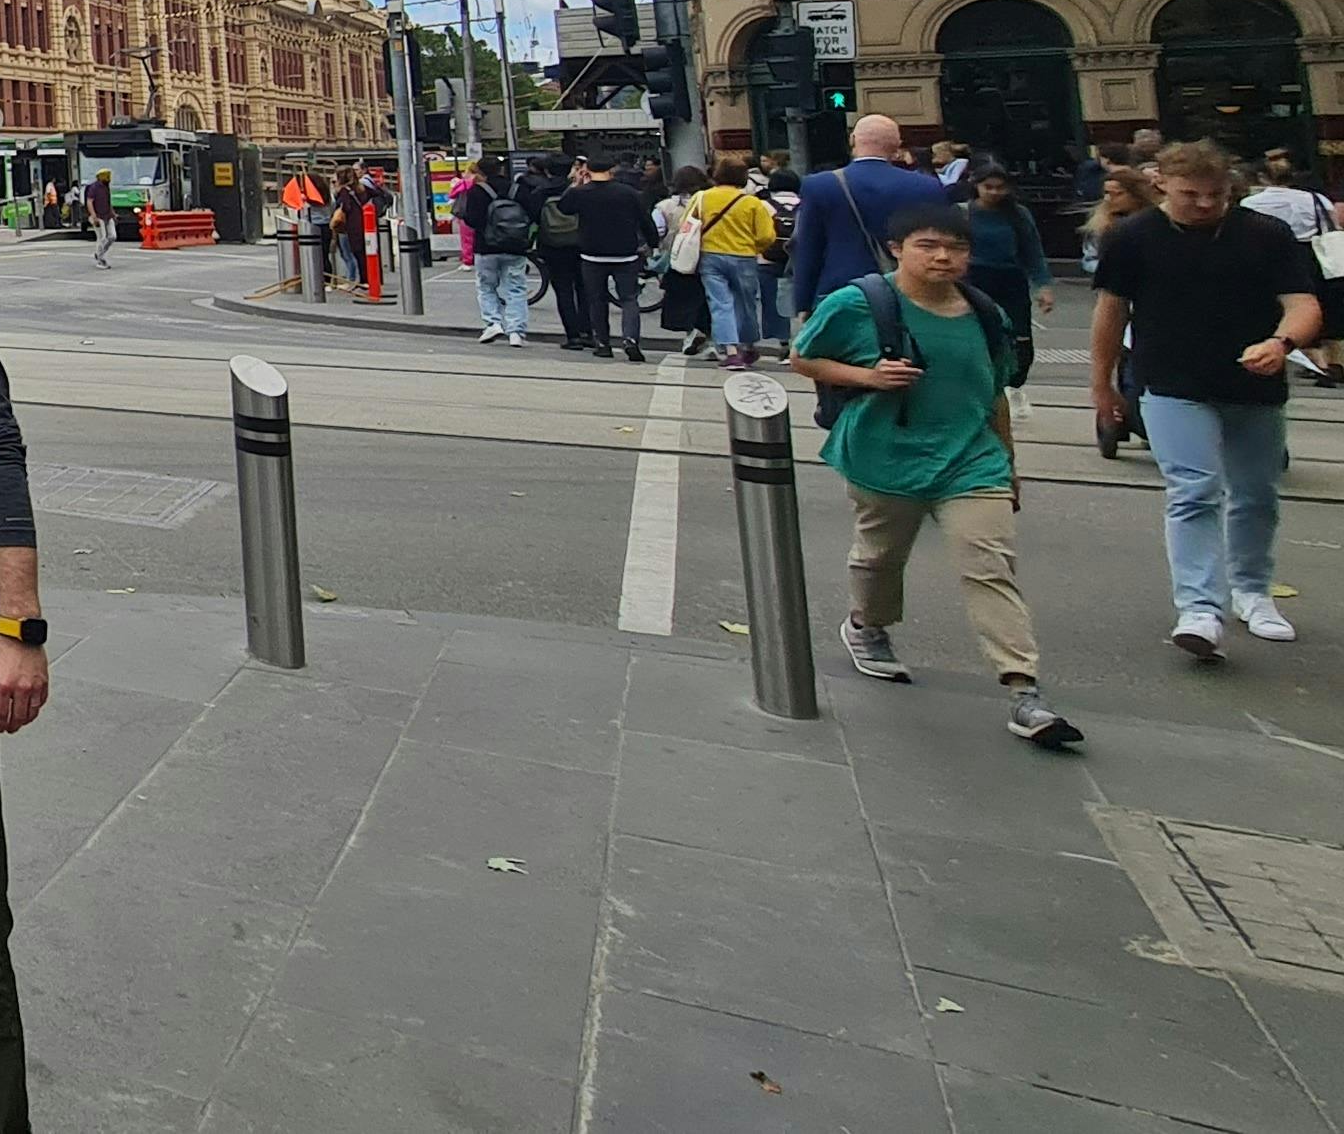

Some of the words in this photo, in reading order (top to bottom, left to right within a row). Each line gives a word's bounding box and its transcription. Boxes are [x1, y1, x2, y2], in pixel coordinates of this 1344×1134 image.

[814, 26, 847, 35] ATCH
[816, 36, 840, 45] FOR
[815, 46, 848, 56] RAMS
